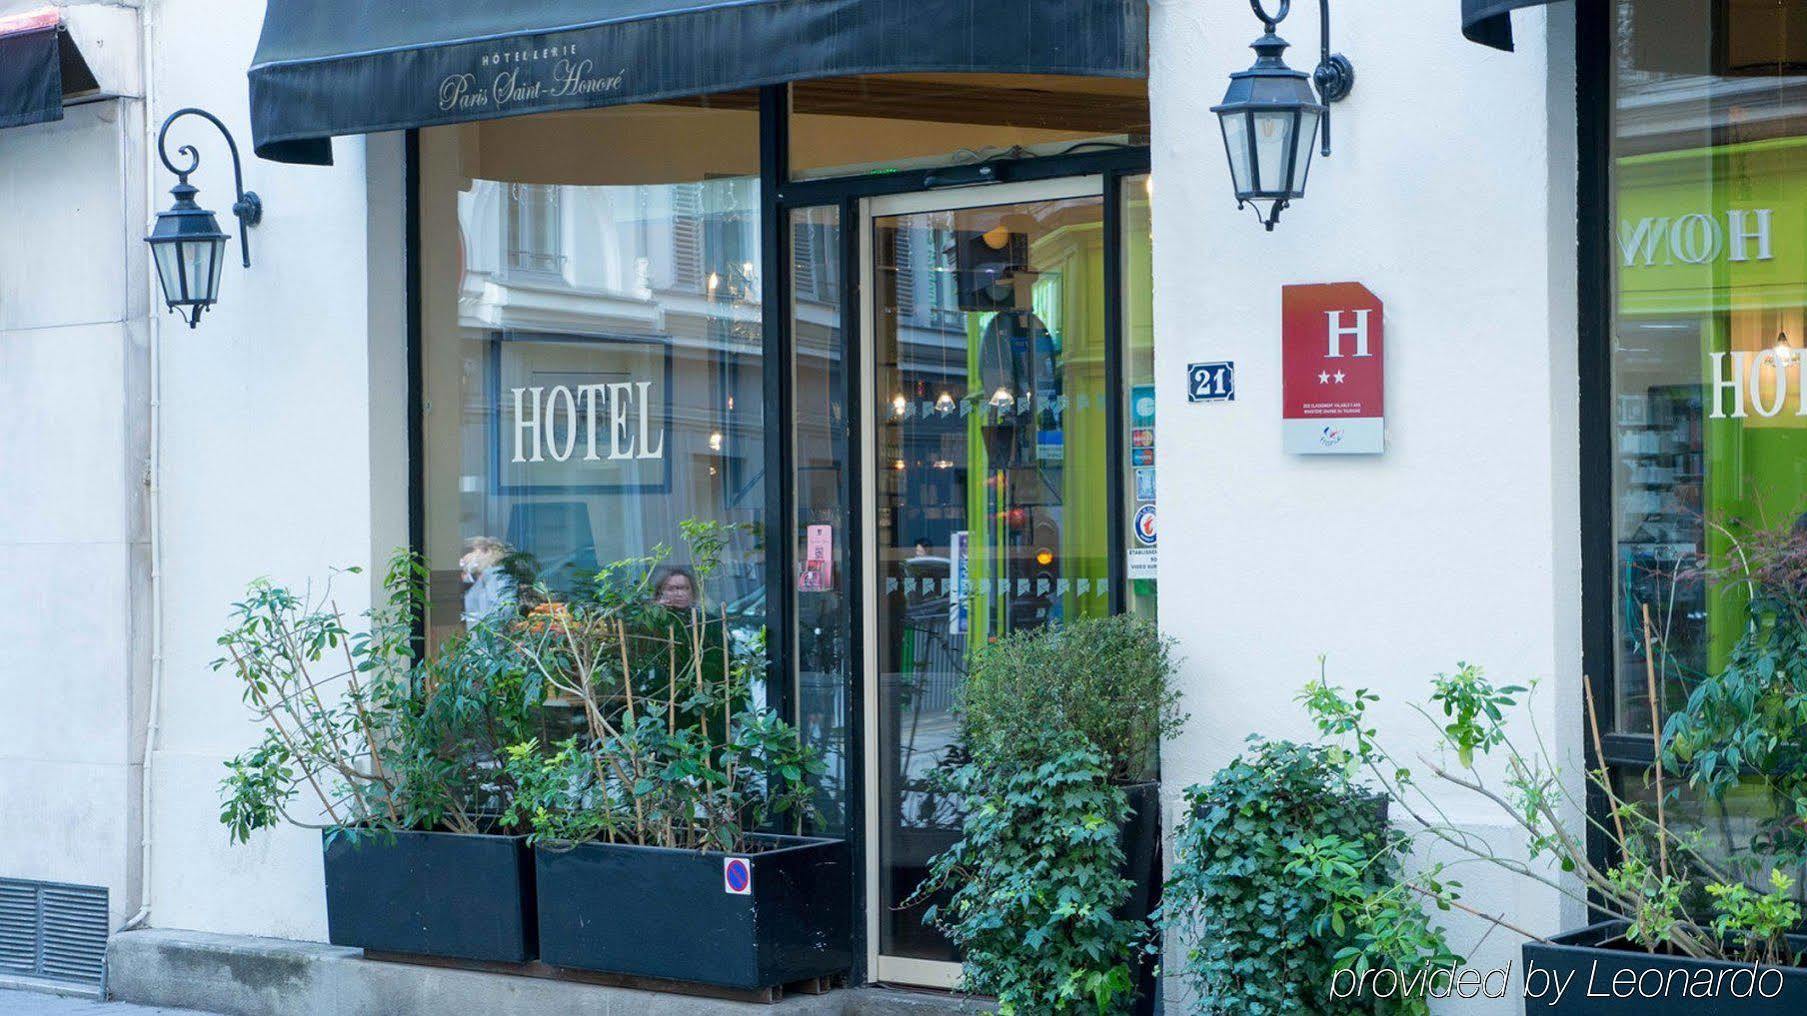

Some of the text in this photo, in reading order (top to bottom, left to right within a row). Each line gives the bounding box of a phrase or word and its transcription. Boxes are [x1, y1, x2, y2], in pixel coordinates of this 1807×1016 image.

[439, 73, 488, 111] Paris
[1323, 308, 1373, 359] H
[1194, 368, 1226, 396] 21
[510, 381, 664, 463] HOTEL
